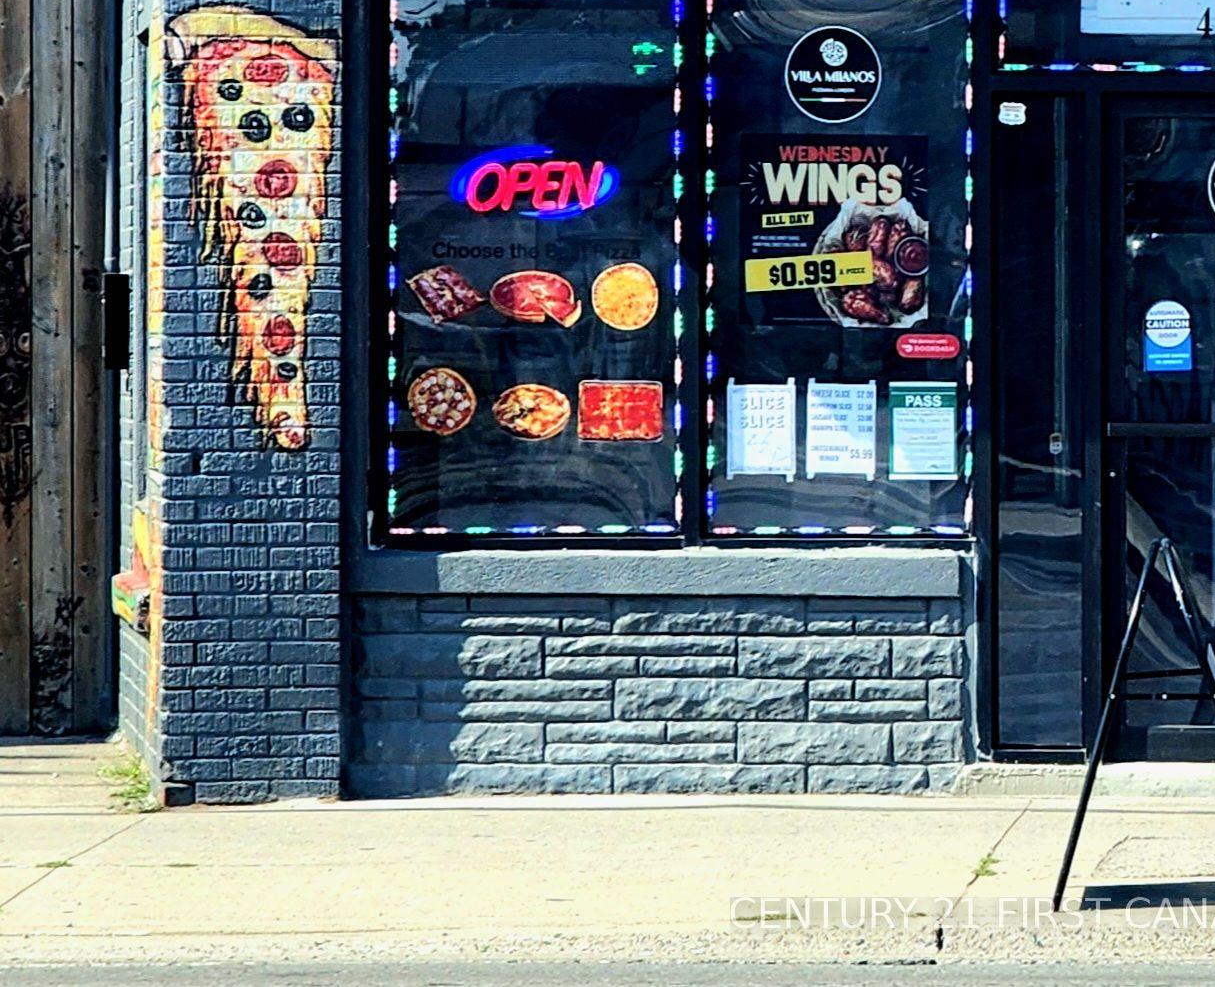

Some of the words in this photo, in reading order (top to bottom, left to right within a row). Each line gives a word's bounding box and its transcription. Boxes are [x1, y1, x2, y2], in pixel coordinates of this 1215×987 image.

[790, 69, 823, 84] VILLA
[824, 70, 877, 84] MILANOS
[778, 145, 889, 164] WEDNESDAY
[466, 161, 604, 212] OPEN
[762, 162, 903, 206] WINGS
[765, 214, 786, 226] ALL
[788, 213, 810, 225] DAY
[431, 241, 505, 260] Choose
[768, 259, 838, 287] $0.99
[1145, 319, 1190, 329] CAUTION
[904, 394, 943, 408] PASS
